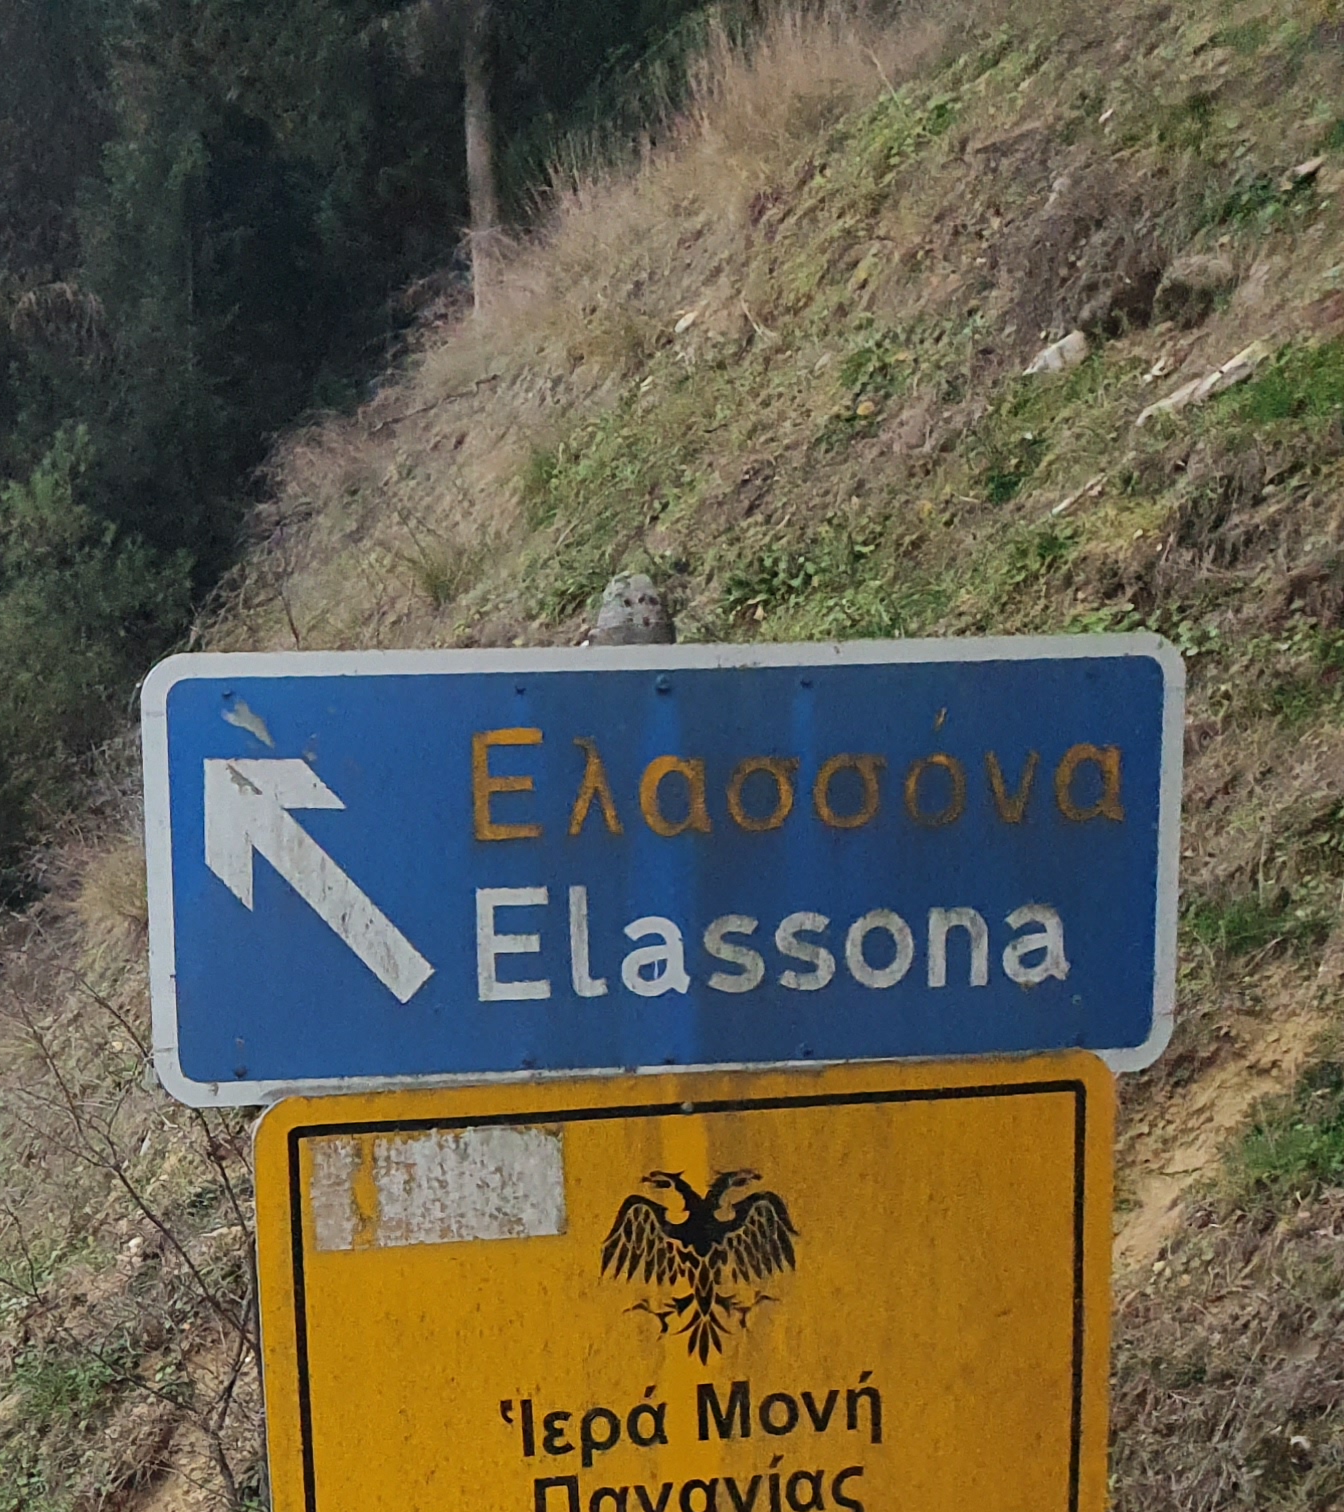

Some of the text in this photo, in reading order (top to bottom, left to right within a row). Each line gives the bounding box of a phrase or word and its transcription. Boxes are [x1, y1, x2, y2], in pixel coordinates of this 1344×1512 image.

[470, 708, 1124, 843] Ελασσόνα
[475, 884, 1070, 1002] Elassona
[696, 1371, 883, 1444] Μονή
